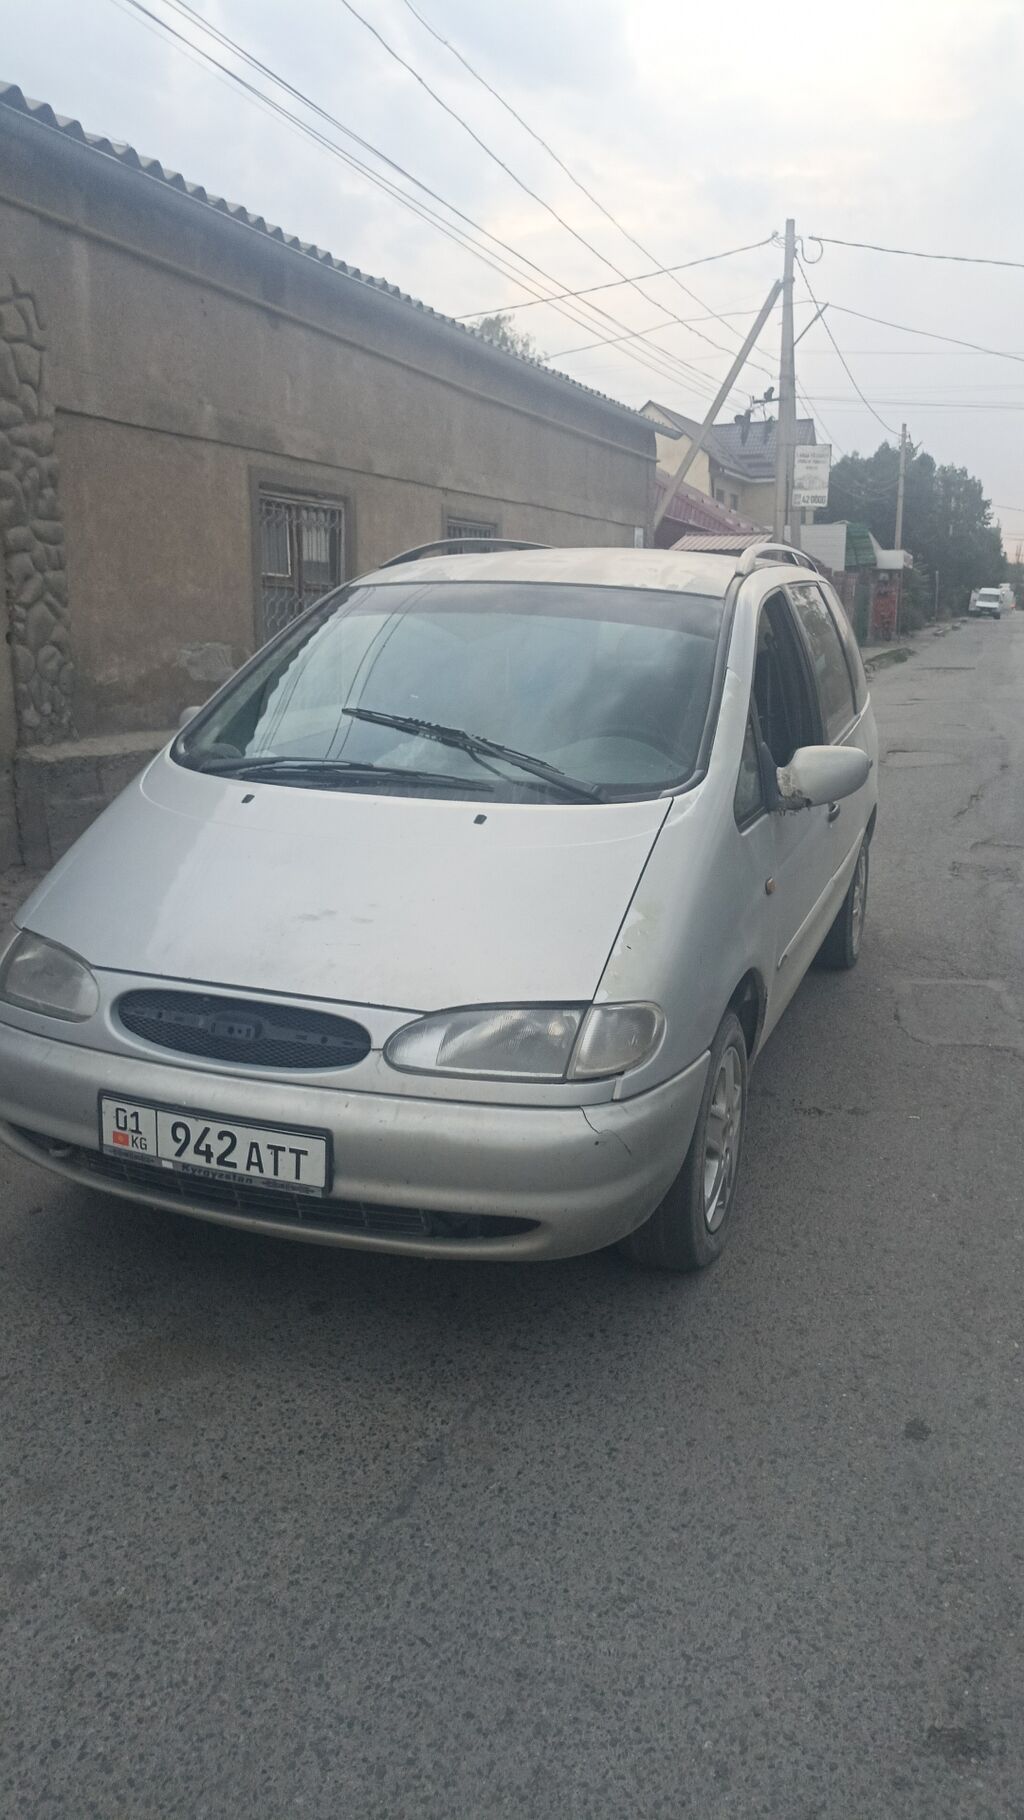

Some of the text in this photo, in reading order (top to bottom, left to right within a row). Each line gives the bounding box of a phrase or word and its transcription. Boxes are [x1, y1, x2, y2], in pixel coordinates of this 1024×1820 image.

[115, 1107, 143, 1136] 01
[131, 1135, 148, 1152] KG
[181, 1163, 253, 1184] Kyrgyzstan
